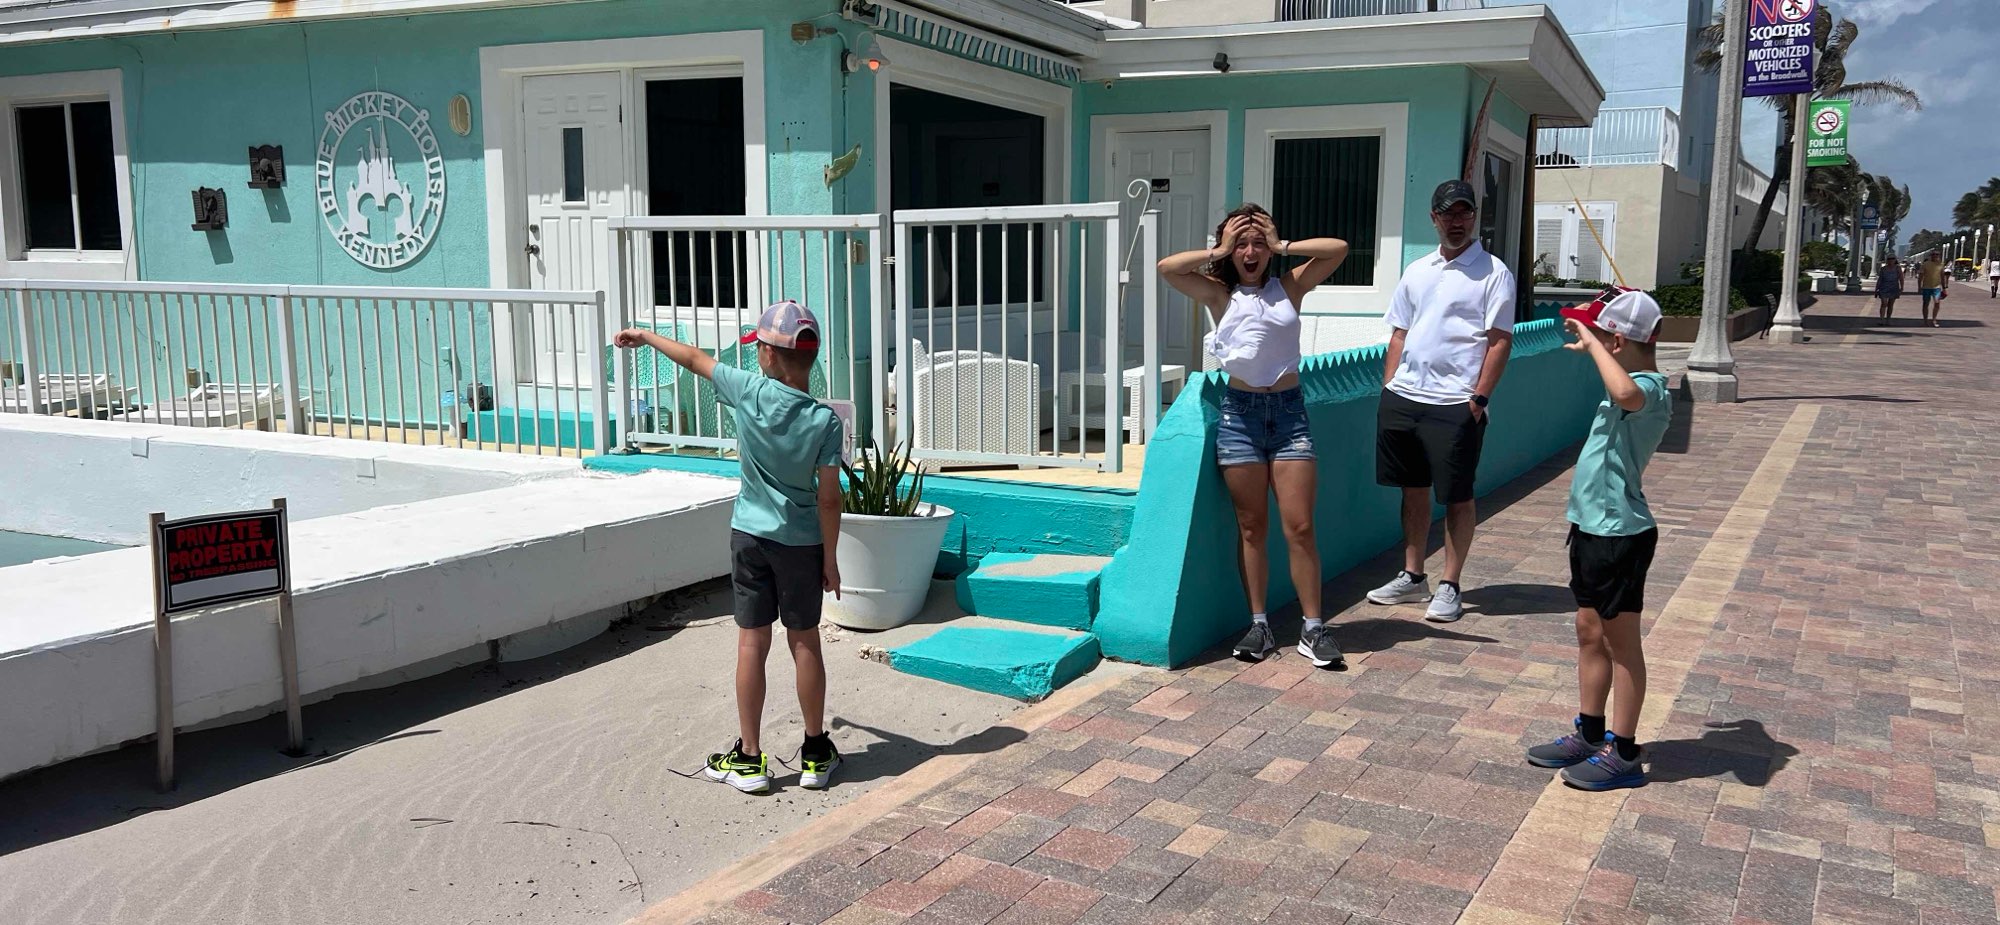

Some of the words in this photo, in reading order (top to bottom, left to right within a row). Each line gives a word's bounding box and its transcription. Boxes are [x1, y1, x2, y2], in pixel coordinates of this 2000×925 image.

[1750, 23, 1811, 41] SCOOTERS
[1774, 38, 1794, 47] OTHER
[1747, 45, 1810, 61] MOTORIZED
[1754, 58, 1802, 72] VEHICLES
[1758, 72, 1769, 81] the
[1771, 69, 1808, 80] Broadwalk
[1809, 139, 1824, 148] FOR
[1827, 138, 1844, 146] NOT
[317, 140, 337, 216] BLUE
[330, 94, 405, 135] MICKEY
[408, 118, 443, 217] HOUSE
[1807, 147, 1845, 157] SMOKING
[338, 225, 427, 265] KENNEDY
[176, 519, 263, 549] PRIVATE
[169, 538, 275, 571] PROPERTY
[189, 559, 277, 578] TRESPASSING
